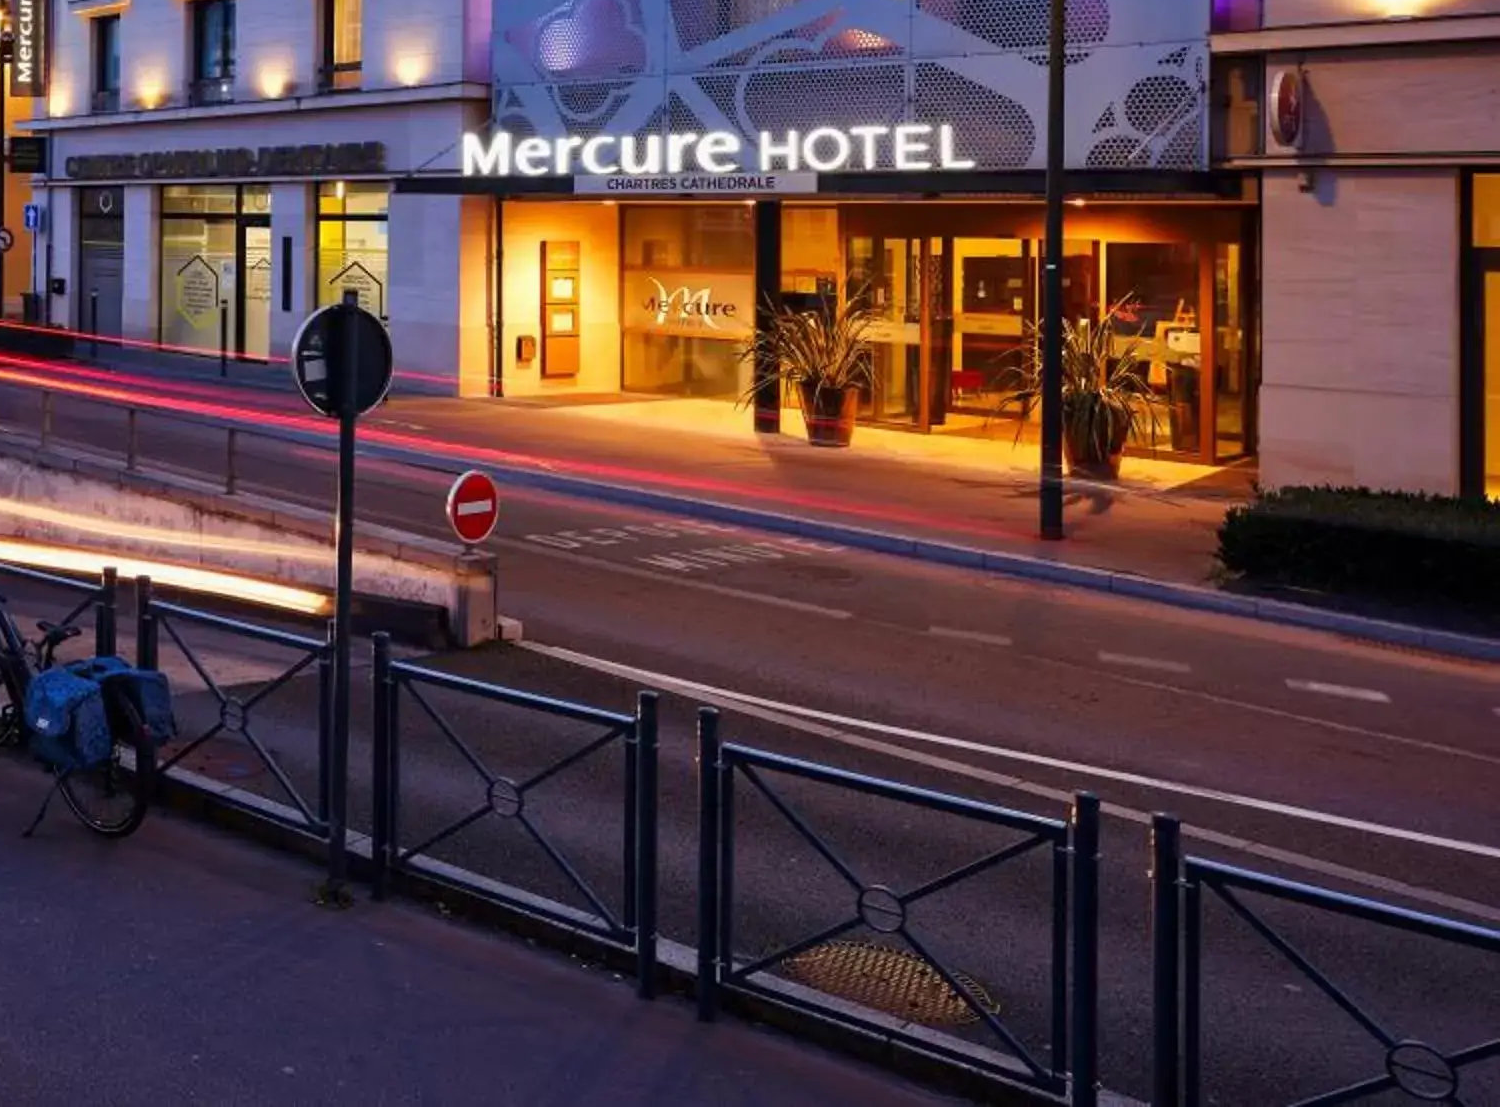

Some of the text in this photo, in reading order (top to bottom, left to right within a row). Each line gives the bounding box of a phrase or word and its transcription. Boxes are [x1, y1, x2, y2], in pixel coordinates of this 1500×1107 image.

[462, 123, 977, 177] Mercure HOTEL
[606, 175, 776, 191] CHARTRES CATHEDRALE
